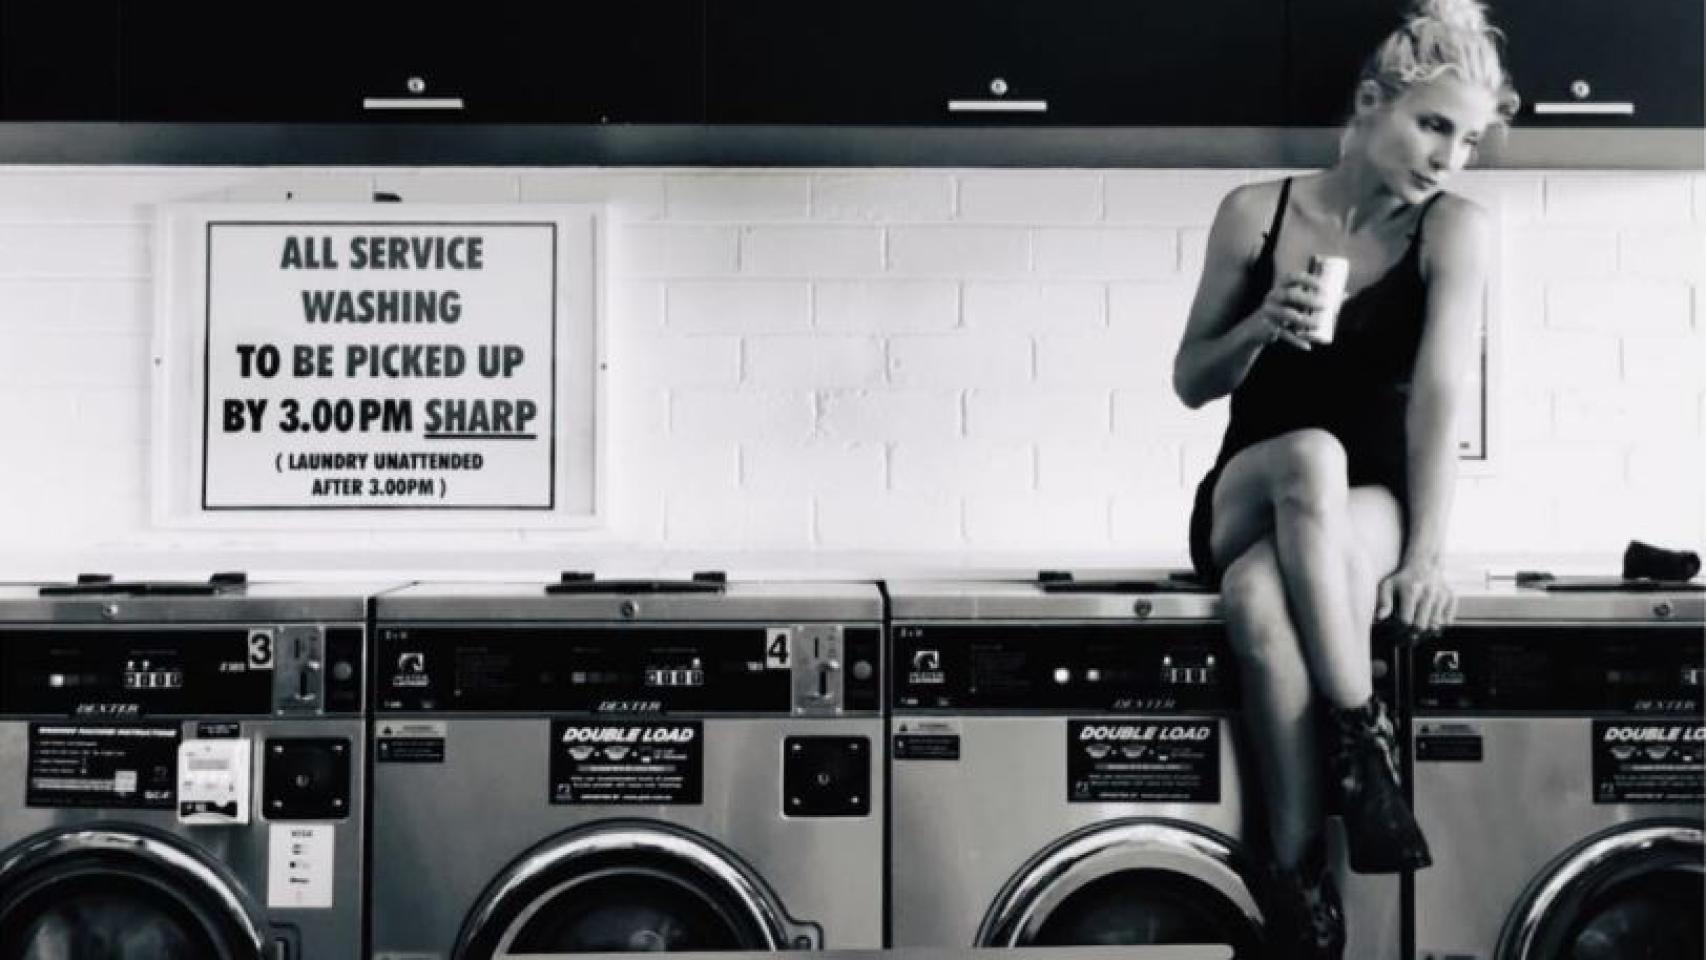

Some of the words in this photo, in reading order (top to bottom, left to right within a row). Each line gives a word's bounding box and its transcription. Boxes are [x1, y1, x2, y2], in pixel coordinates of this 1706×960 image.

[281, 236, 338, 269] ALL
[350, 236, 483, 269] SERVICE
[302, 289, 461, 324] WASHING
[236, 344, 281, 379] TO
[293, 344, 333, 378] BE
[346, 344, 466, 379] PICKED
[478, 345, 524, 379] UP
[222, 398, 268, 433] BY
[423, 398, 537, 436] SHARP
[288, 453, 368, 471] LAUNDRY
[373, 452, 484, 471] UNATTENDED
[312, 478, 363, 497] AFTER
[368, 478, 434, 497] 3.00PM
[251, 633, 273, 665] 3
[768, 634, 789, 664] 4
[562, 726, 641, 743] DOUBLE
[642, 726, 694, 743] LOAD
[1079, 726, 1156, 741] DOUBLE
[1158, 726, 1210, 741] LOAD
[1604, 726, 1681, 742] DOUBLE
